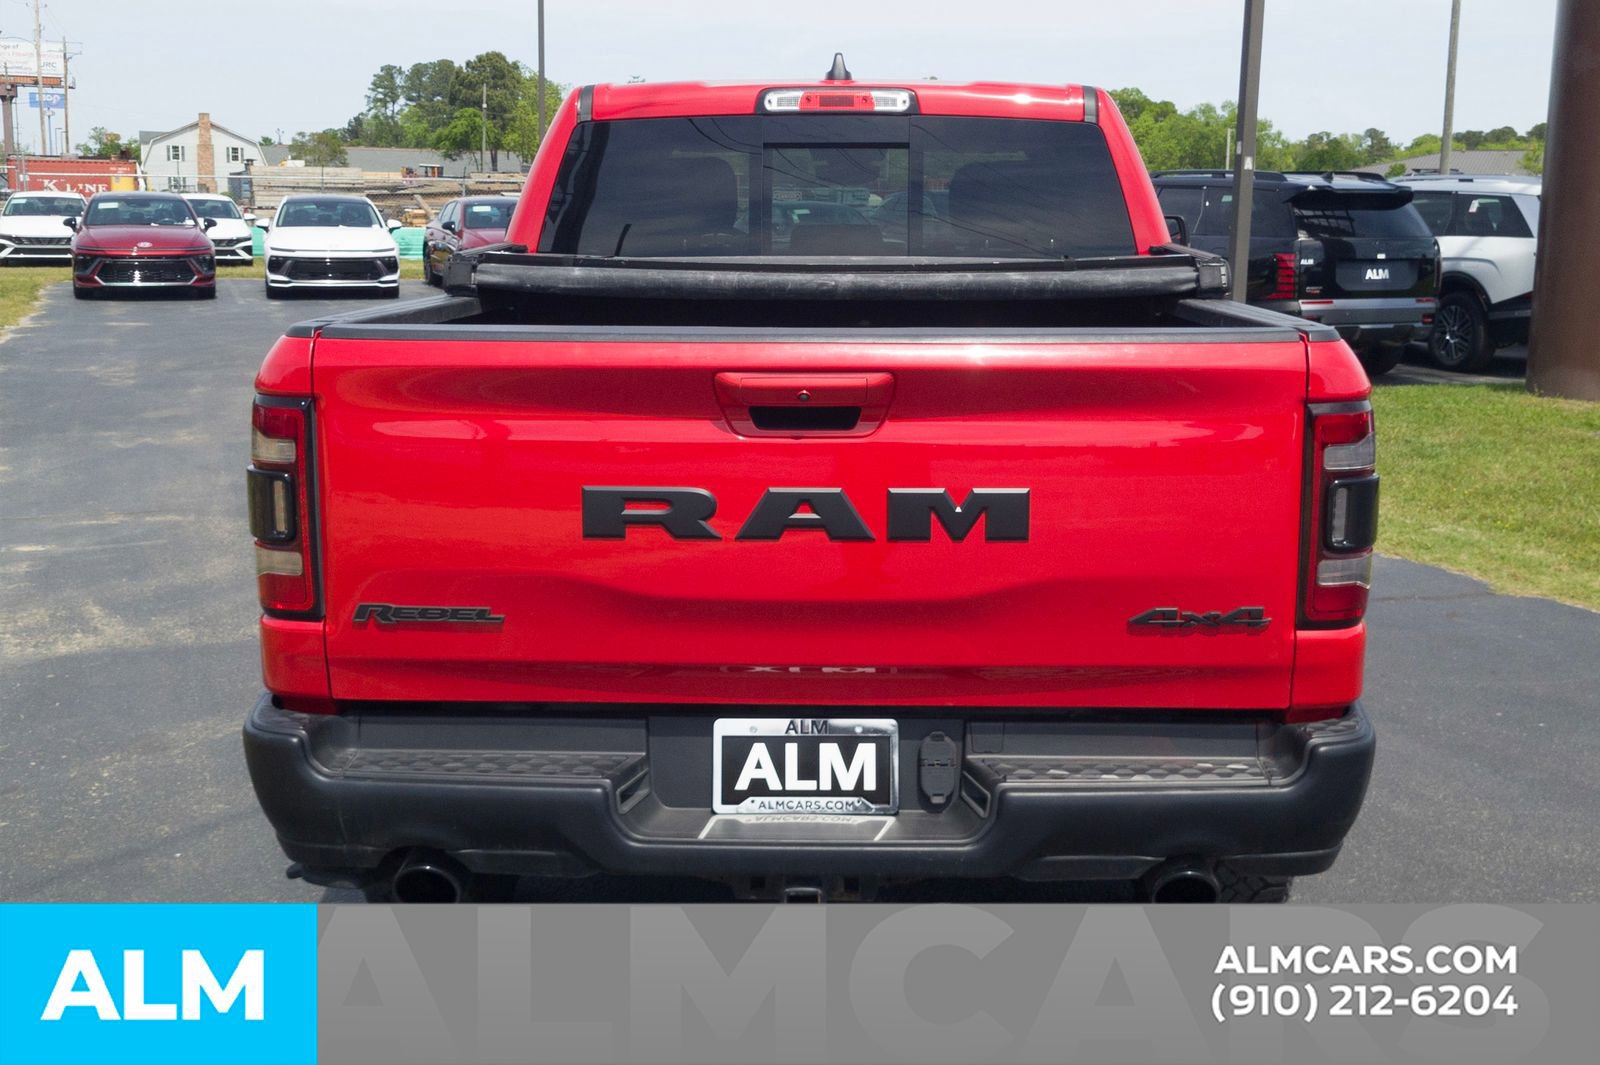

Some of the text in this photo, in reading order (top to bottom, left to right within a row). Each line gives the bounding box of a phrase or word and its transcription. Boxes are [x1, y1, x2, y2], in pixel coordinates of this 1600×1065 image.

[1365, 268, 1390, 280] ALM
[581, 485, 1031, 542] RAM
[1128, 606, 1272, 628] 4x4
[784, 719, 829, 735] ALM
[734, 742, 877, 791] ALM
[758, 800, 854, 810] ALMCARS.COM
